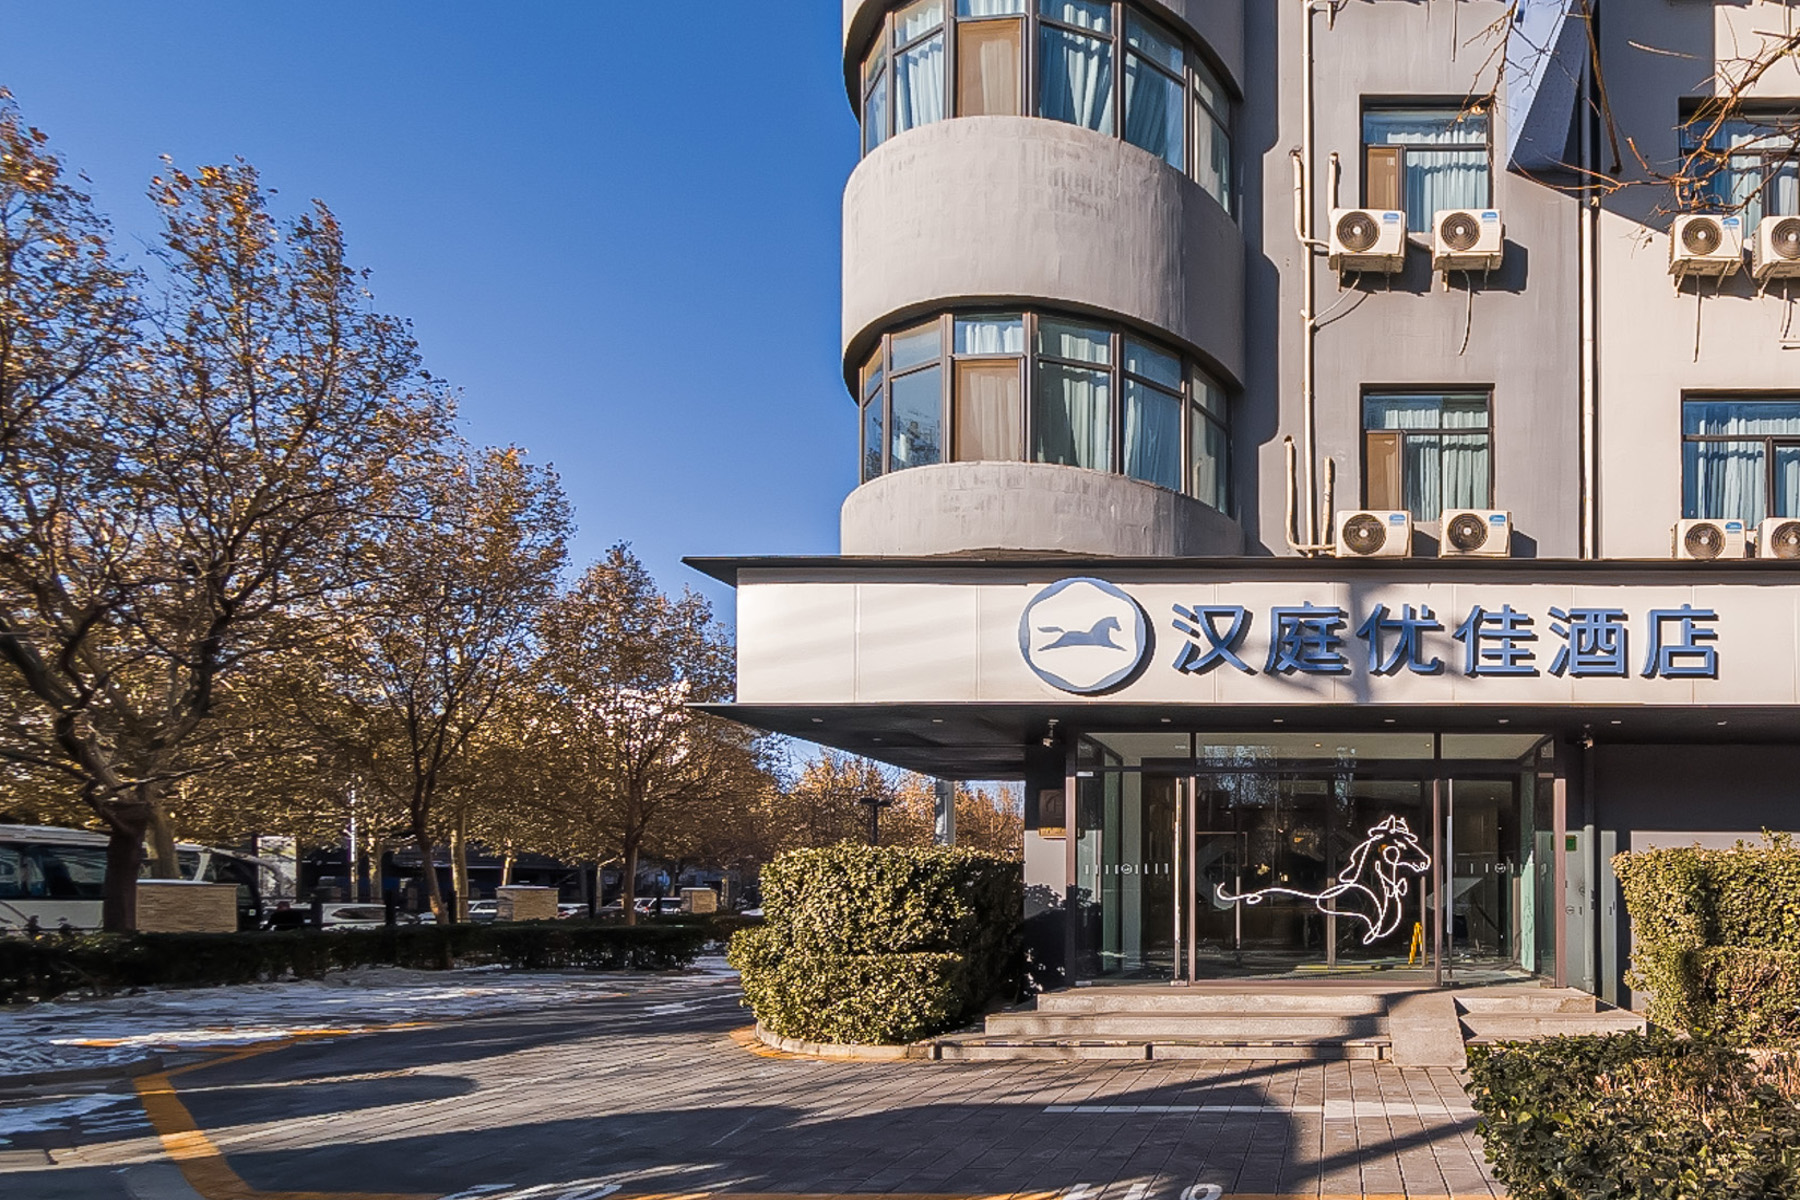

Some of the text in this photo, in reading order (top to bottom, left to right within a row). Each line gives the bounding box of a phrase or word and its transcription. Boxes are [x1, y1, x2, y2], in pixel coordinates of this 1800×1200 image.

[1172, 602, 1719, 677] 汉庭优佳酒店
